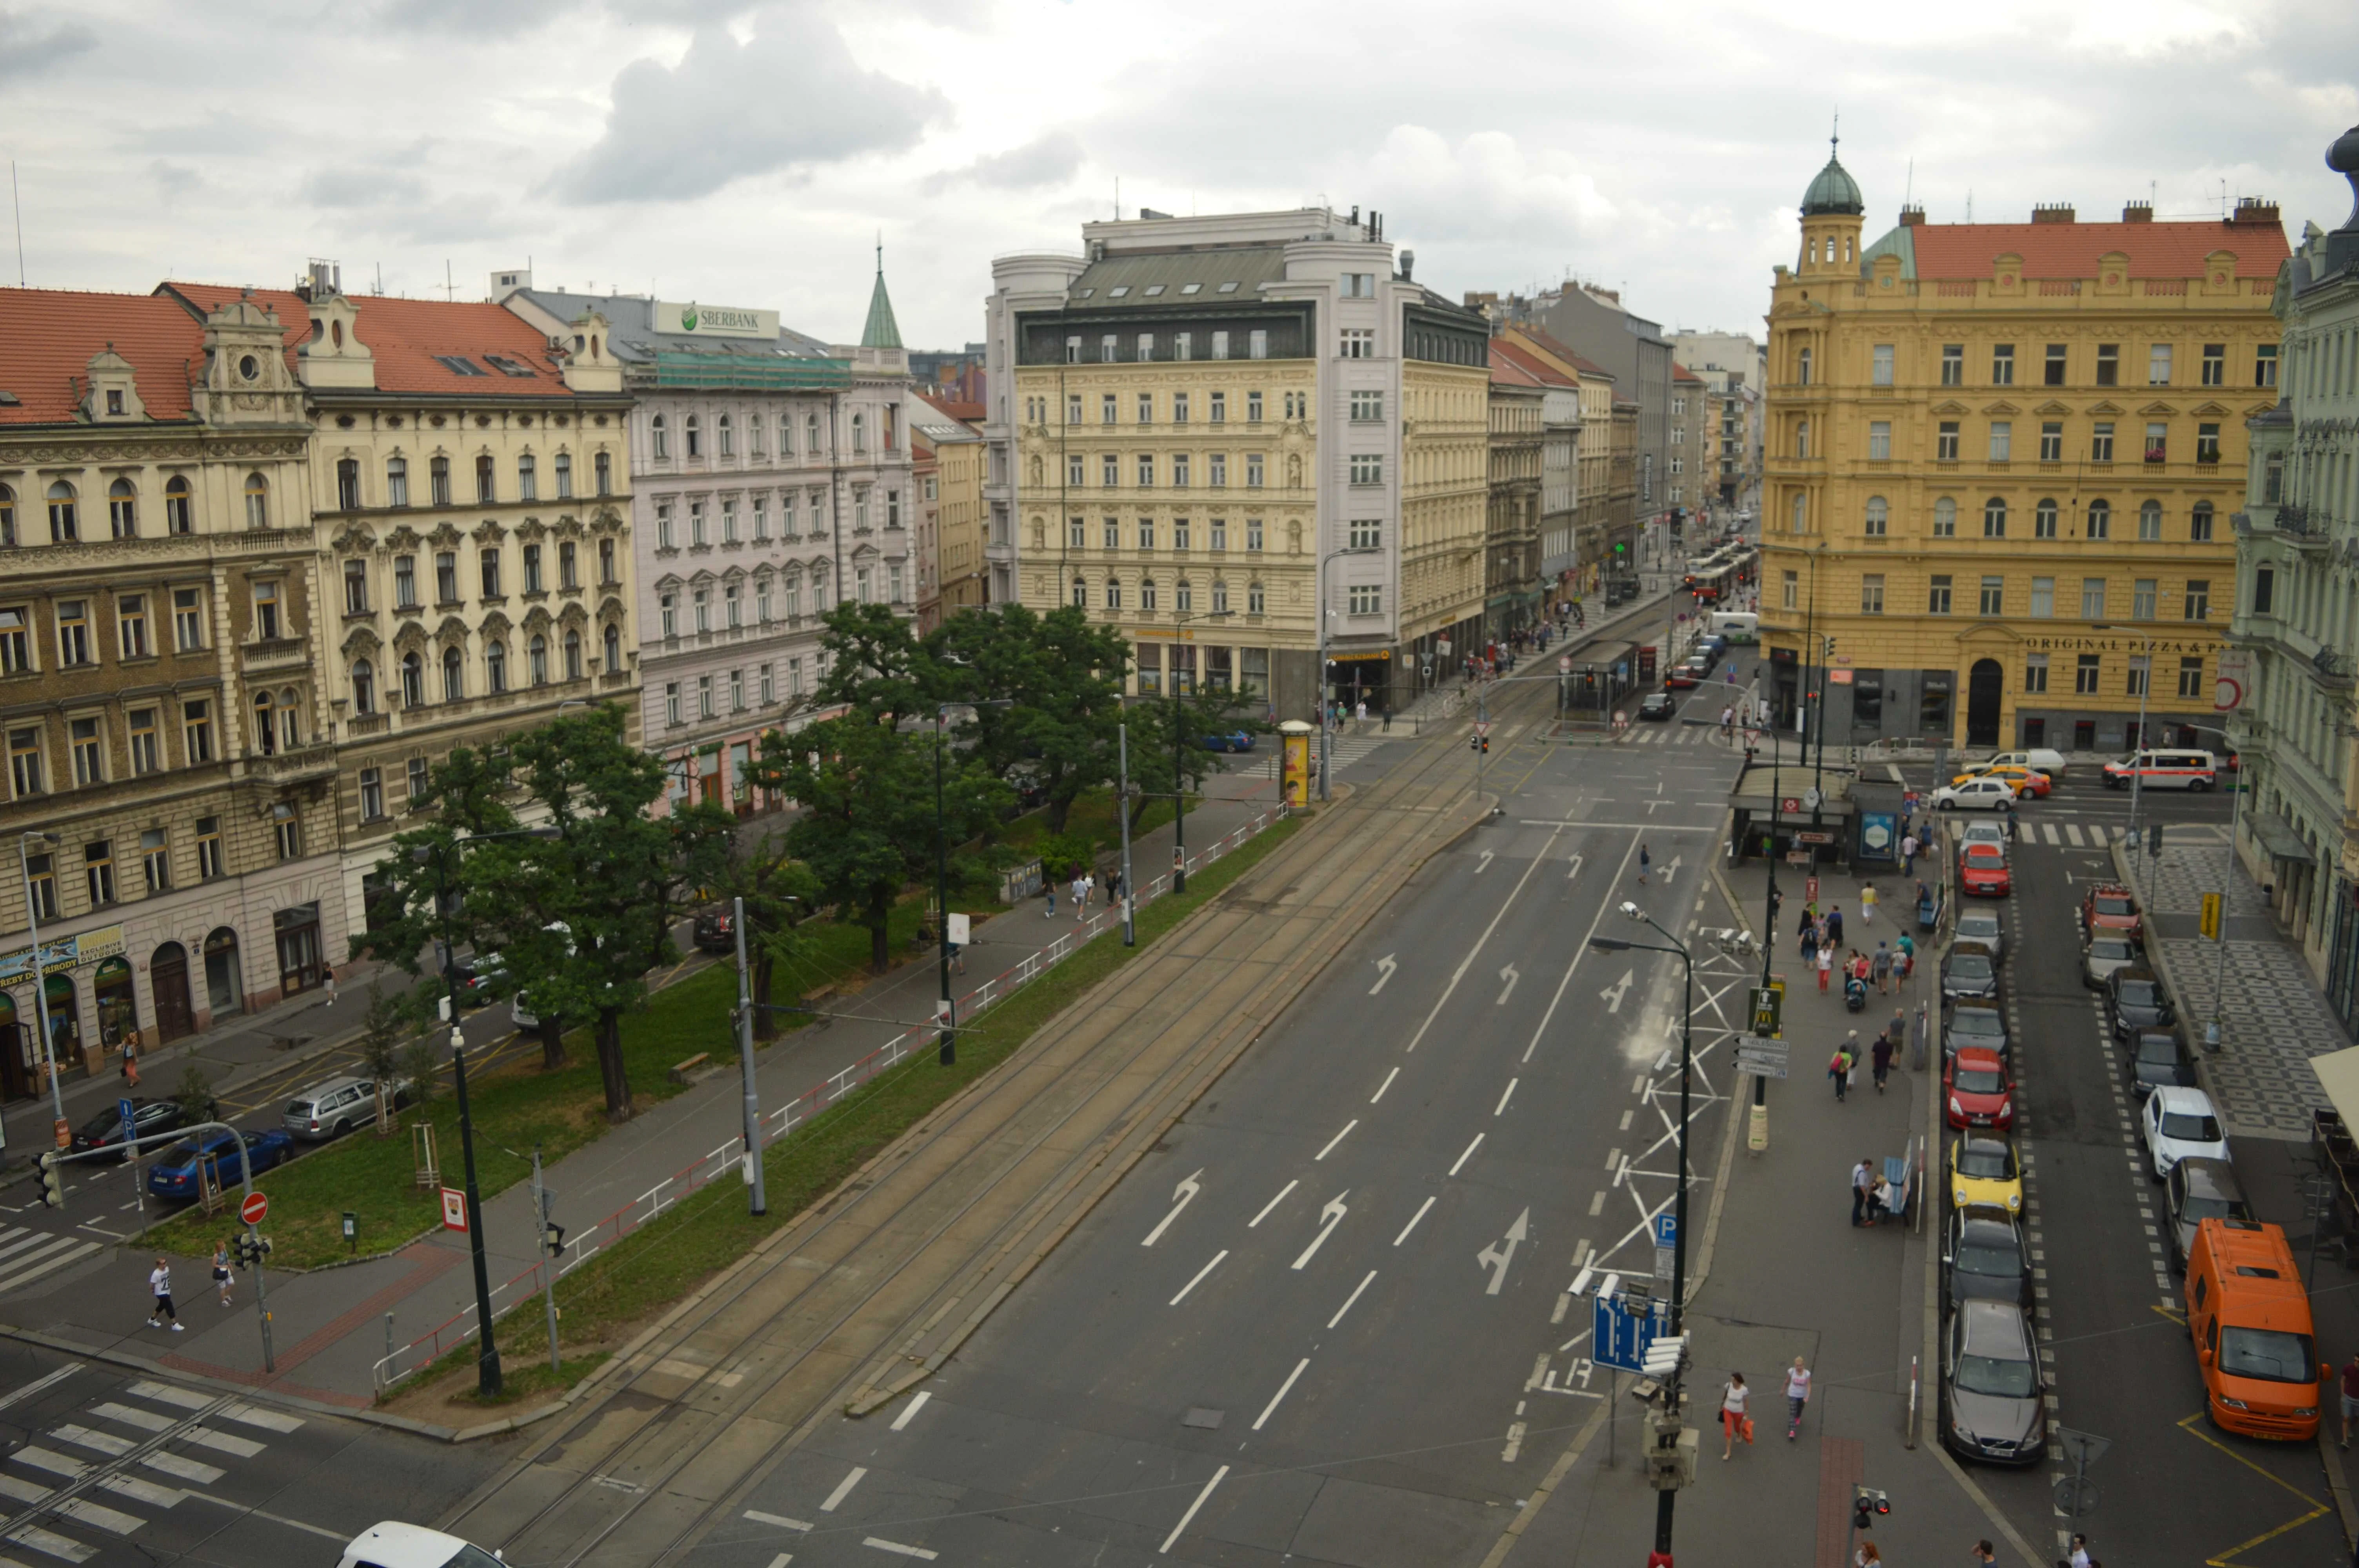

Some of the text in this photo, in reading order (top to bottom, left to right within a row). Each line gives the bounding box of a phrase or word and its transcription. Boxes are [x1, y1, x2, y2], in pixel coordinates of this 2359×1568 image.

[701, 310, 759, 328] SBERBANK
[2026, 638, 2120, 650] ORIGINAL
[2129, 641, 2182, 652] PIZZA
[2189, 642, 2200, 652] &
[80, 941, 122, 956] EXCLUSIVE
[81, 947, 123, 962] OUTDOOR
[25, 971, 37, 980] DO
[1662, 1218, 1676, 1236] P
